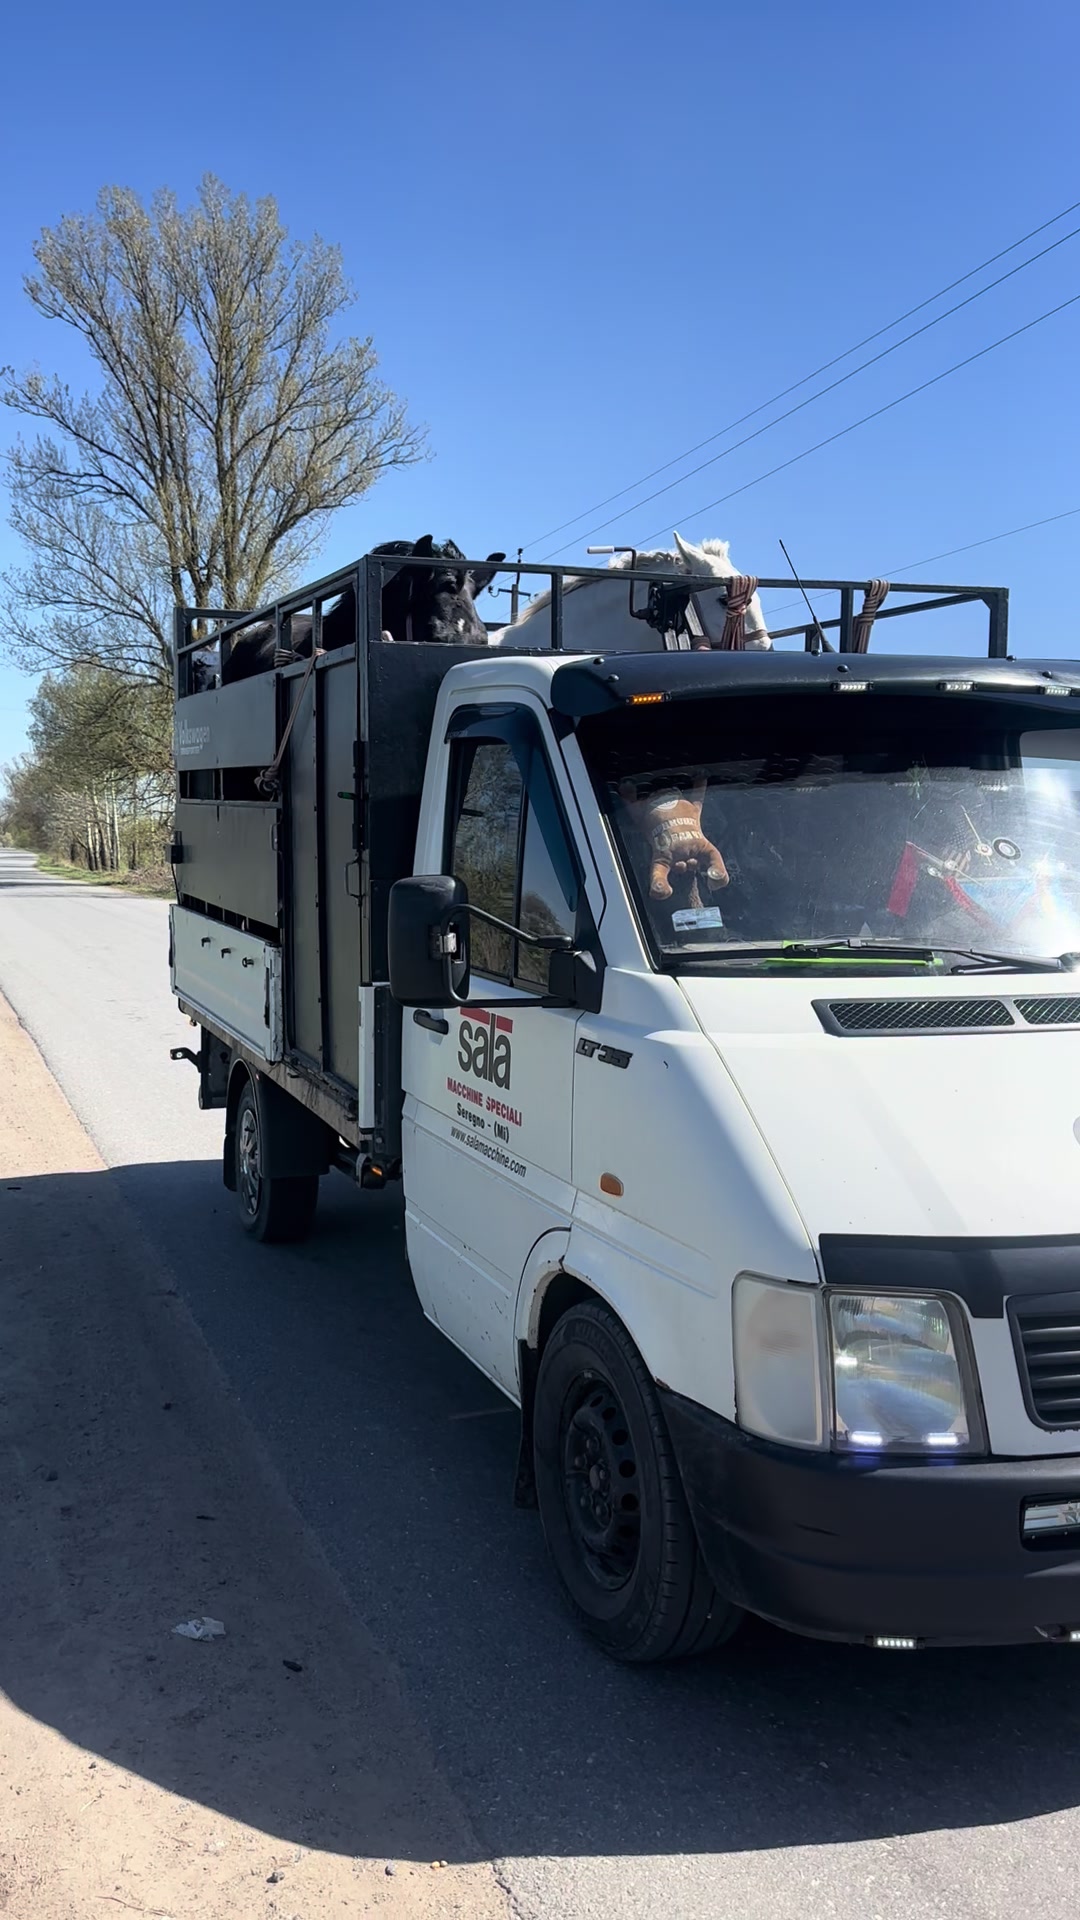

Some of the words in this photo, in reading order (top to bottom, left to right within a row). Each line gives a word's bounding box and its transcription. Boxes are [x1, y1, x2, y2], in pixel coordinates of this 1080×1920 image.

[458, 1013, 511, 1090] sala
[576, 1037, 602, 1059] LT
[446, 1077, 483, 1107] MACCHINE
[486, 1096, 522, 1126] SPECIALI
[456, 1103, 485, 1129] Seregno
[494, 1121, 510, 1143] (Mi)
[450, 1126, 527, 1178] www.salamacchine.com
